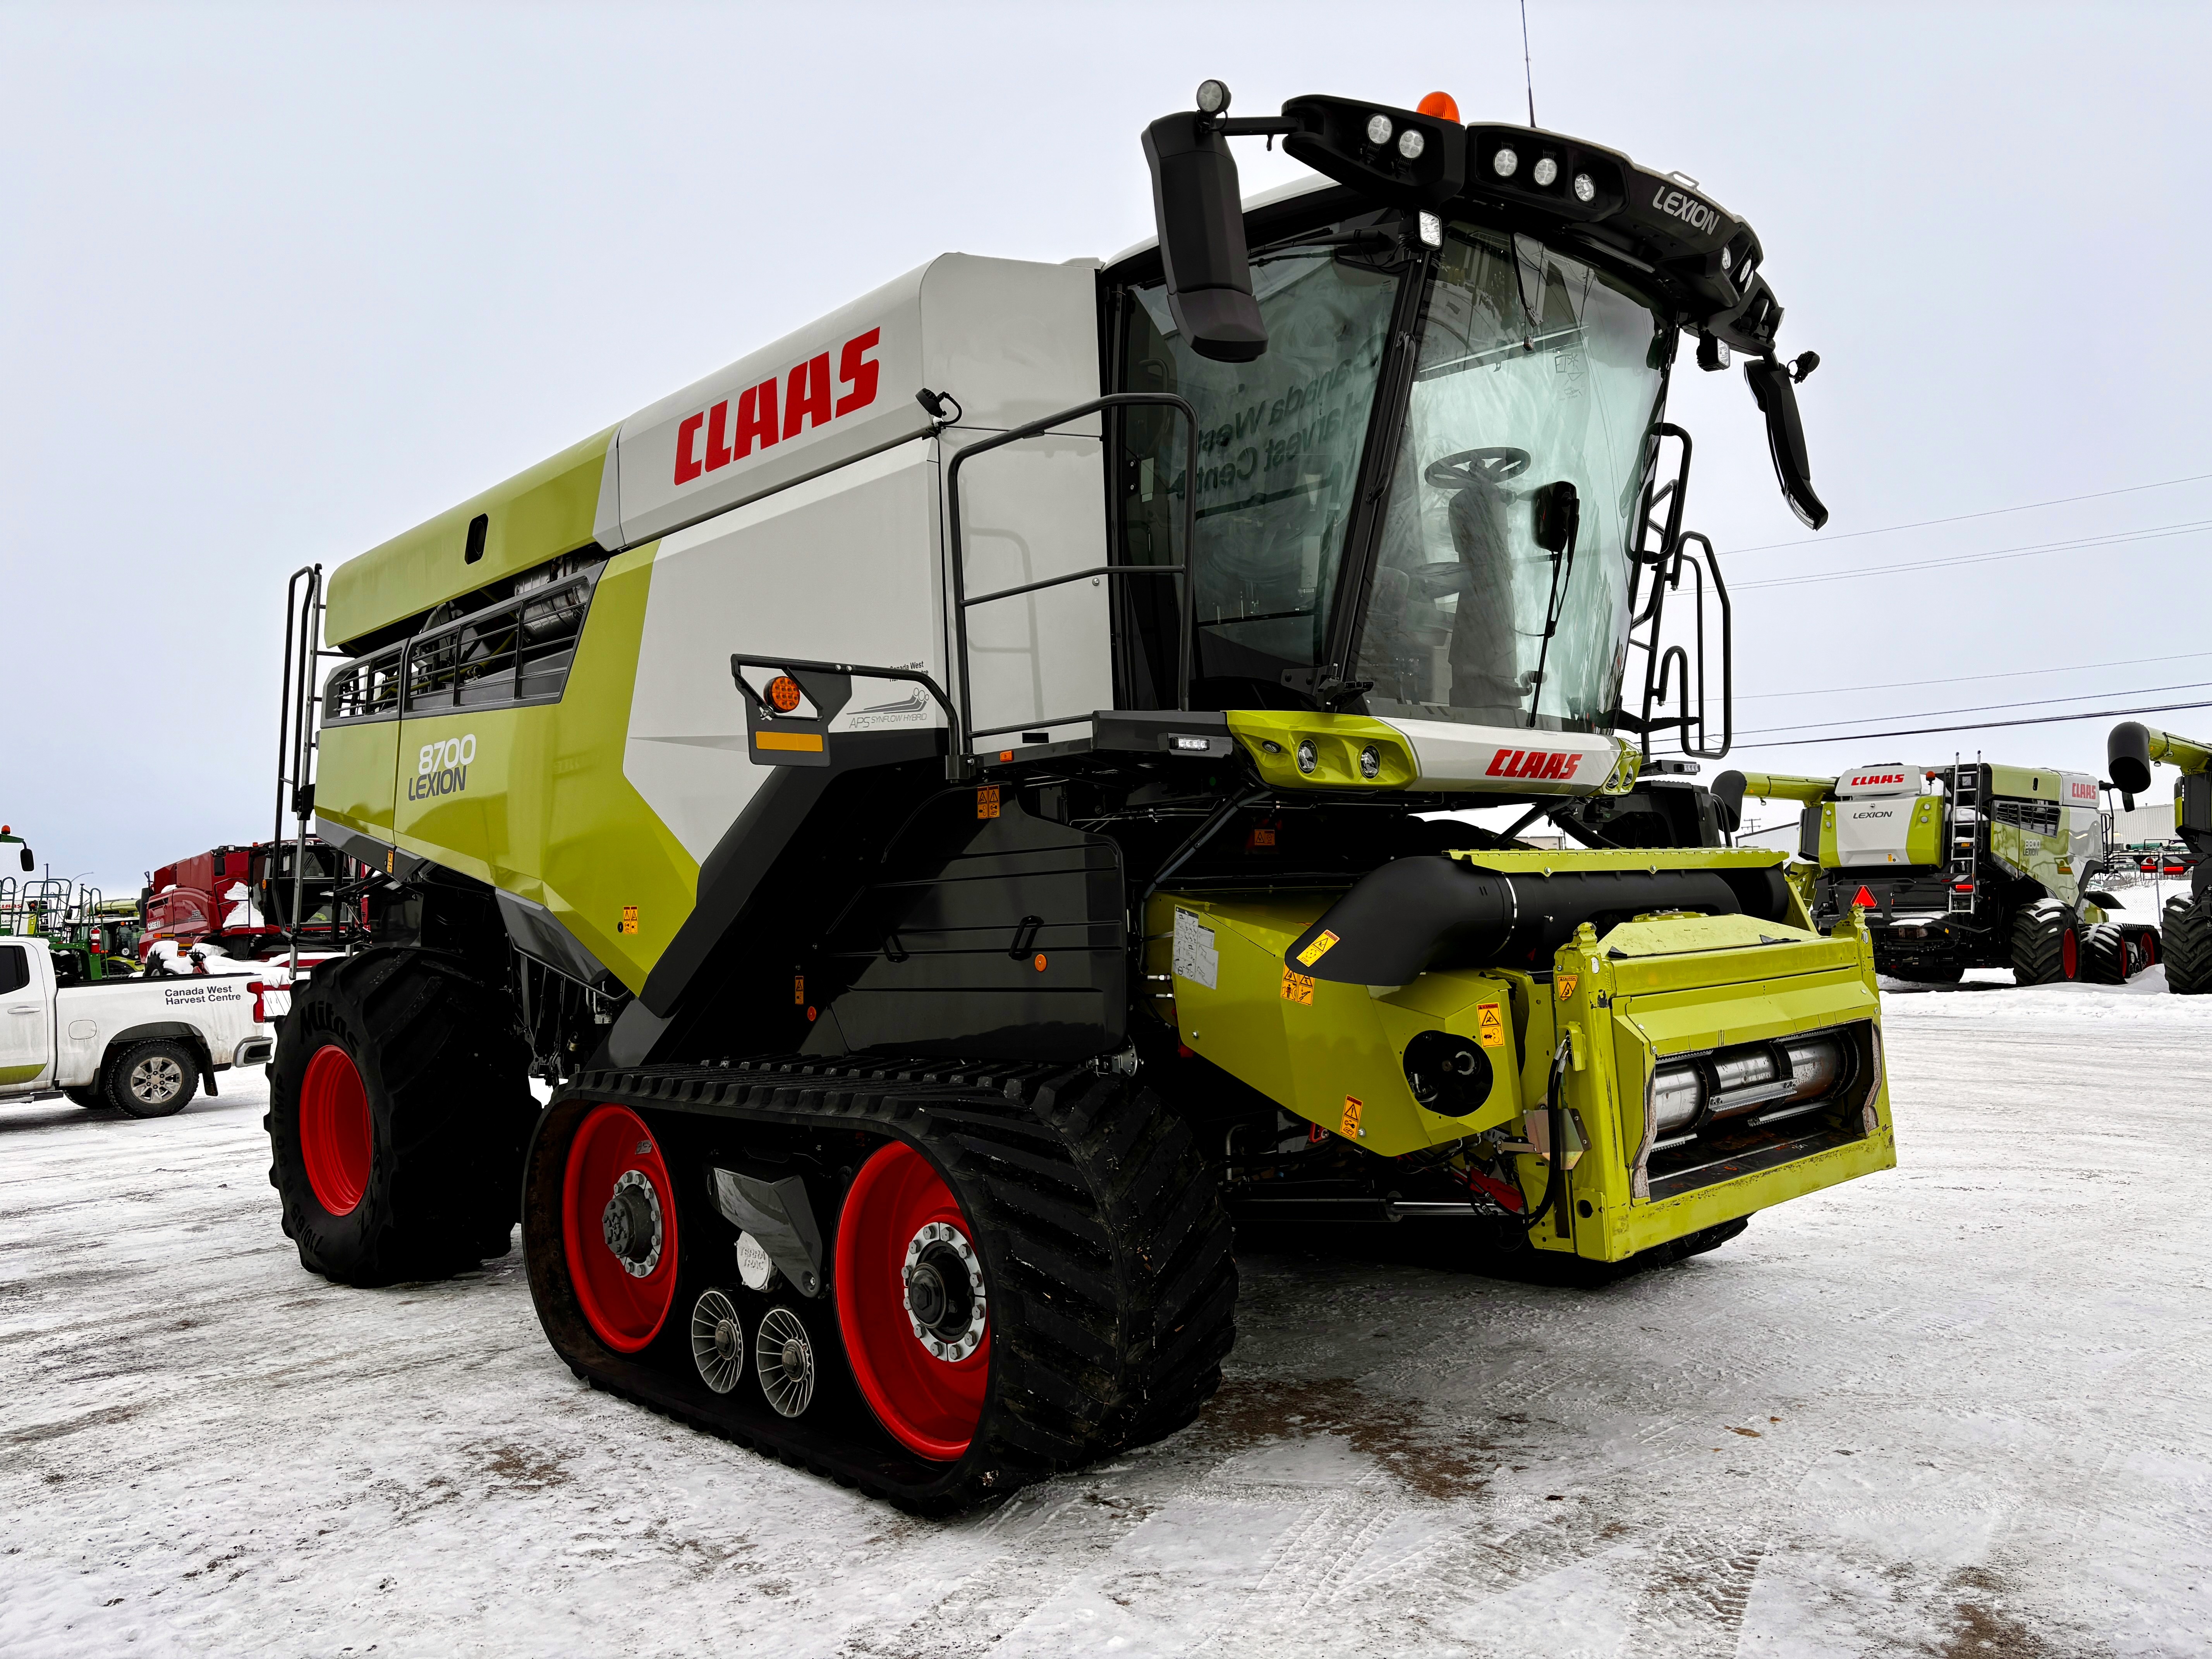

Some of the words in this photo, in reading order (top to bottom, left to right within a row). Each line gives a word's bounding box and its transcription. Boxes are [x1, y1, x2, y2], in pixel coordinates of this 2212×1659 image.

[1653, 186, 1720, 235] LEXION
[674, 326, 880, 486] CLAAS
[910, 661, 924, 669] West
[849, 717, 870, 728] APS
[871, 715, 902, 723] SYNFLOW
[419, 734, 476, 775] 8700
[1485, 749, 1583, 779] CLAAS
[409, 765, 466, 801] LEXION
[1851, 774, 1905, 786] CLAAS
[2072, 783, 2096, 799] CLAAS
[2025, 840, 2040, 849] 8800
[165, 988, 204, 997] Canada
[207, 986, 232, 994] West
[166, 996, 205, 1005] Harvest
[300, 1001, 359, 1060] Mitas
[741, 1247, 765, 1260] TERRA
[744, 1258, 764, 1270] TRAC
